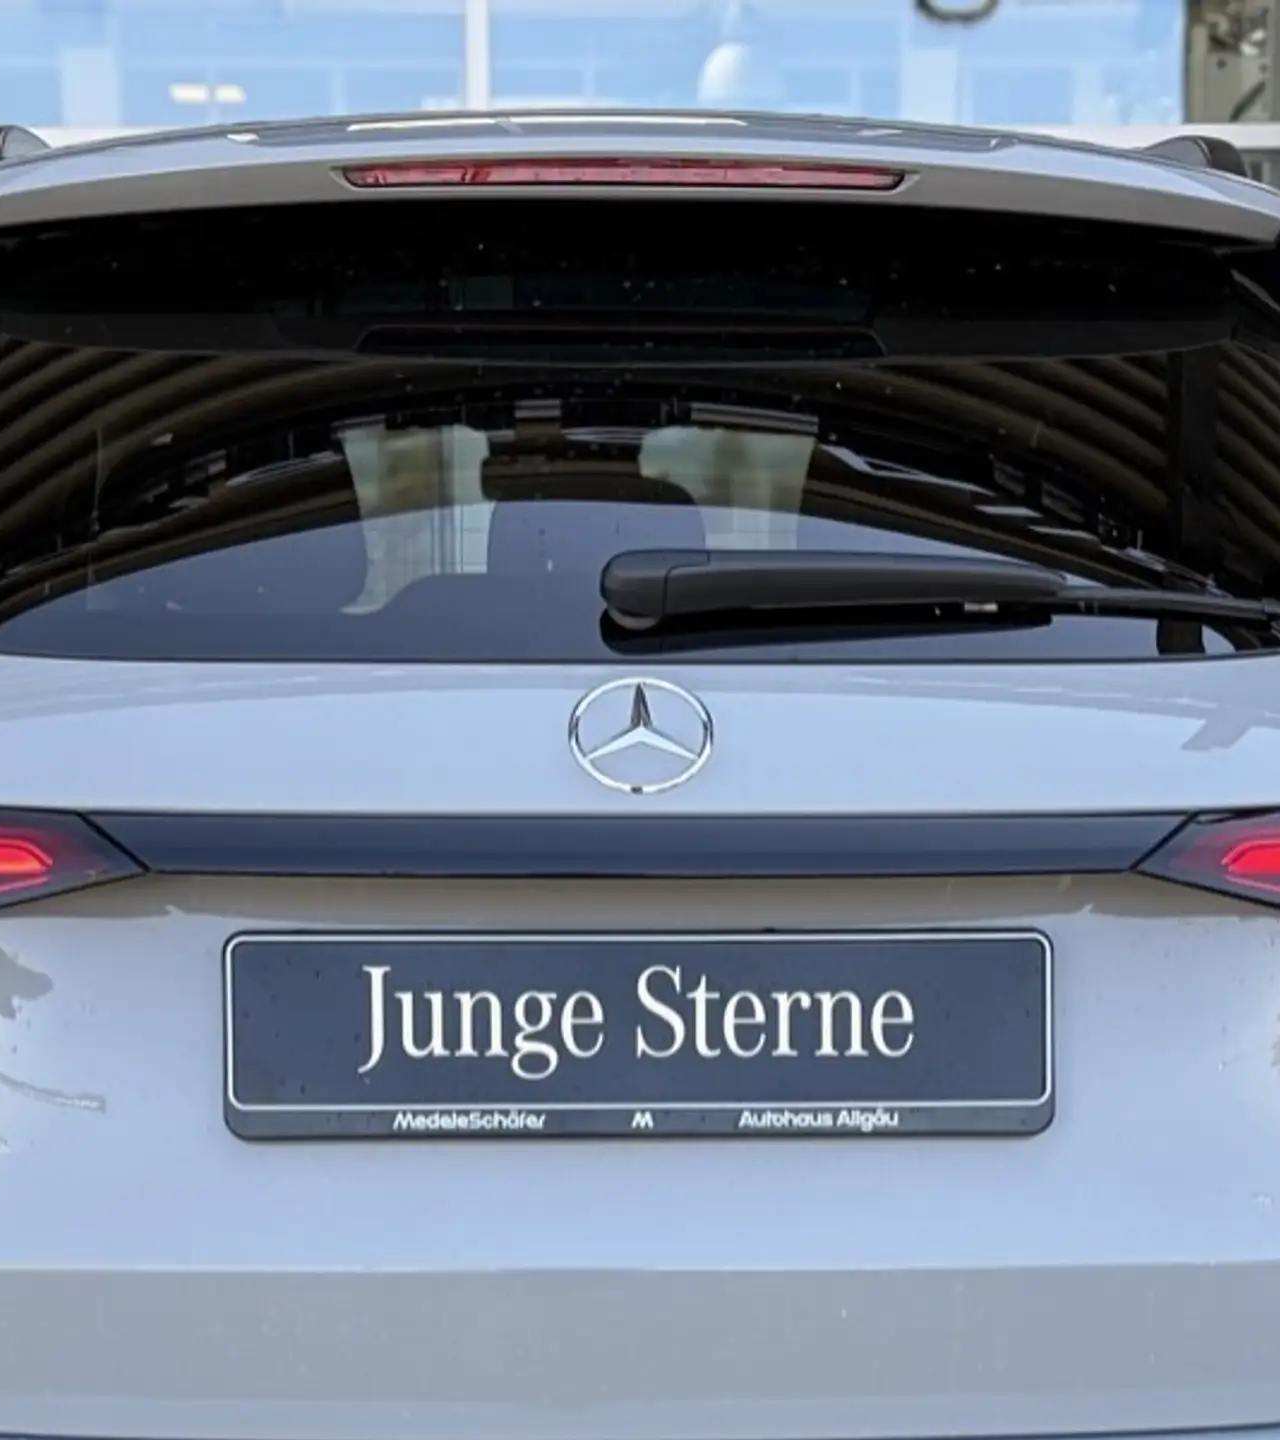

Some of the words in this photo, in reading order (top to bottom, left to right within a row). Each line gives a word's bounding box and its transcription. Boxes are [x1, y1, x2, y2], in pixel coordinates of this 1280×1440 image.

[357, 965, 605, 1080] Junge
[635, 964, 915, 1059] Sterne
[392, 1109, 547, 1130] MedeleSchäfer
[738, 1109, 833, 1129] Autohaus
[836, 1107, 899, 1132] Allgäu
